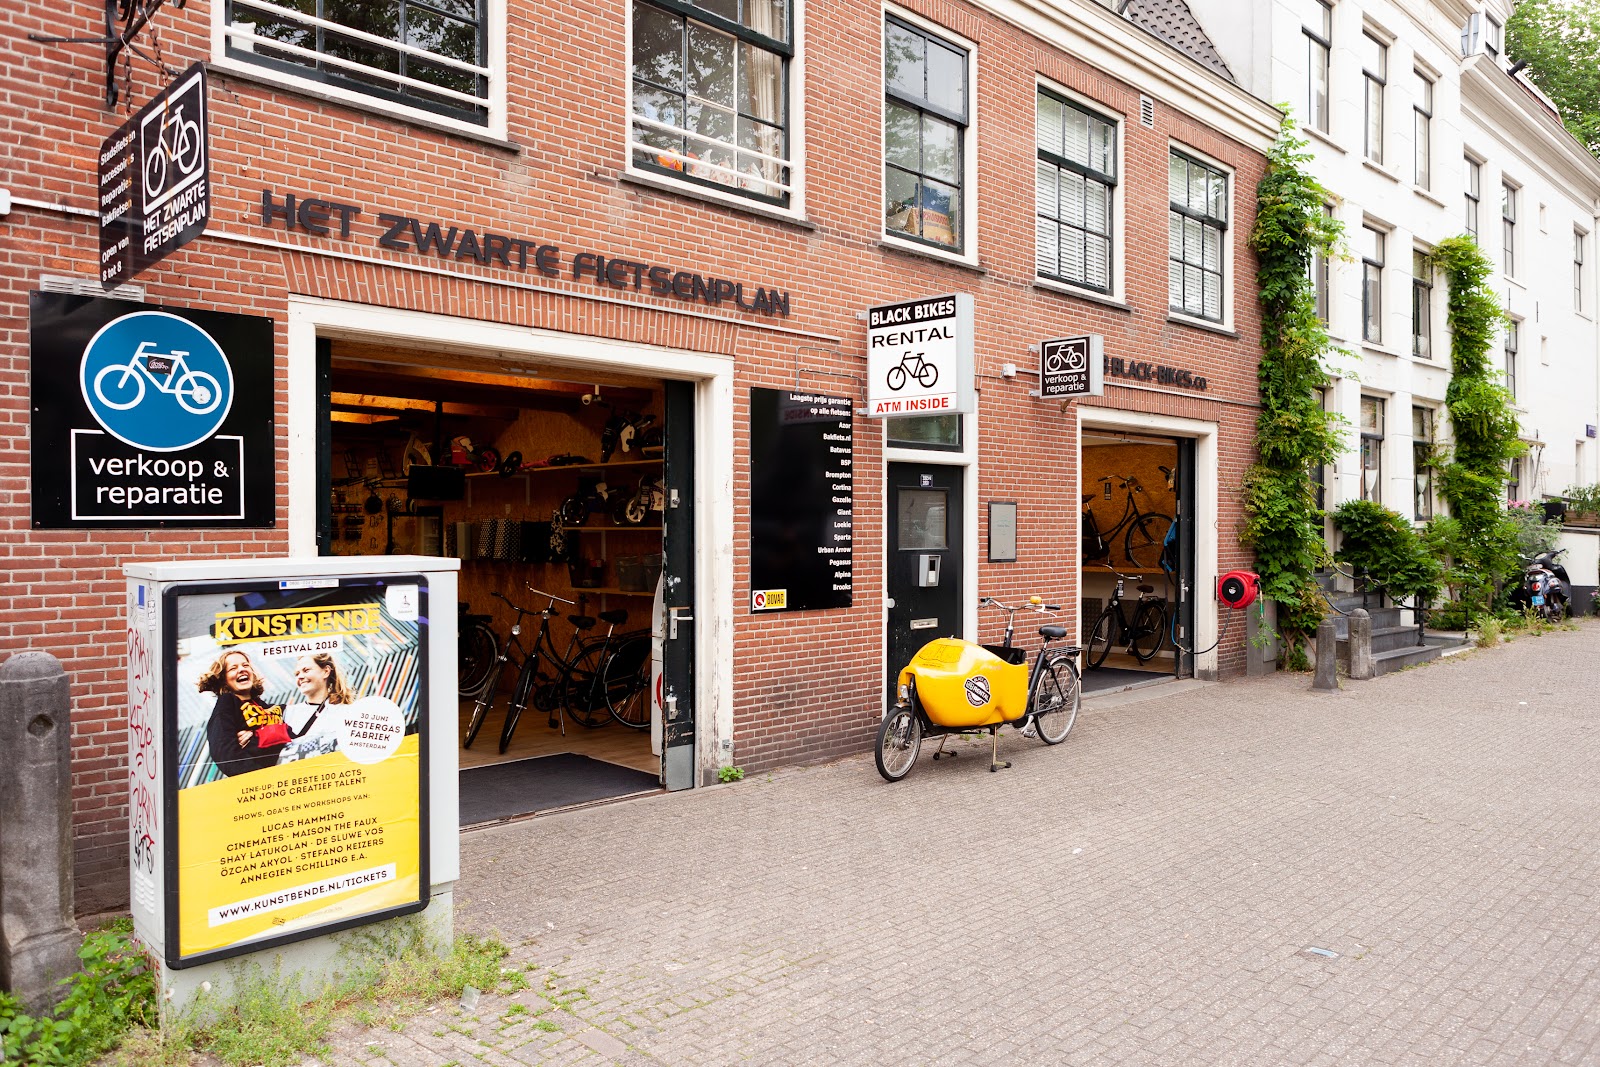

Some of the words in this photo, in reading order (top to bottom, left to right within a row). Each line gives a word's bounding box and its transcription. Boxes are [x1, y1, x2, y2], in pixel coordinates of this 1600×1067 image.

[100, 130, 136, 166] Stadsfietsen
[101, 153, 134, 186] Accessoires
[101, 178, 132, 207] Reparaties
[102, 199, 132, 227] Bakfietsen
[143, 209, 161, 236] HET
[164, 179, 205, 223] ZWARTE
[144, 199, 206, 255] FIETSENPLAN
[102, 245, 117, 263] Open
[118, 237, 129, 250] van
[262, 189, 360, 238] HET
[379, 211, 560, 276] ZWARTE
[574, 251, 789, 316] FIETSENPLAN
[102, 270, 107, 281] 8
[108, 265, 116, 279] tot
[117, 261, 122, 273] 8
[871, 307, 911, 326] BLACK
[914, 300, 954, 319] BIKES
[873, 326, 954, 348] RENTAL
[1045, 375, 1079, 384] verkoop
[1046, 382, 1085, 394] reparatie
[790, 393, 813, 403] Laagste
[814, 395, 827, 404] prijs
[828, 398, 851, 406] garantie
[830, 408, 851, 416] fietsen:
[876, 401, 901, 413] ATM
[906, 397, 948, 410] INSIDE
[823, 433, 851, 441] Bakfiets.nl
[89, 453, 203, 481] verkoop
[213, 461, 229, 477] &
[825, 471, 852, 479] Brompton
[96, 483, 223, 509] reparatie
[833, 534, 851, 542] Sparta
[215, 609, 380, 639] KUNSTBENDE
[263, 644, 312, 656] FESTIVAL
[316, 640, 337, 651] 2018
[344, 719, 400, 733] WESTERGAS
[350, 730, 390, 741] FABRIEK
[349, 741, 386, 749] AMSTERDAM
[236, 794, 256, 804] VAN
[259, 789, 286, 800] JONG
[289, 782, 332, 795] CREATIEF
[334, 776, 367, 787] TALENT
[241, 783, 275, 795] LINE-UP:
[277, 779, 289, 788] DE
[291, 775, 318, 786] BESTE
[321, 773, 336, 781] 100
[339, 769, 362, 778] ACTS
[303, 796, 351, 809] WORKSHOPS
[353, 793, 370, 801] VAN:
[227, 834, 284, 852] CINEMATES
[292, 826, 331, 839] MAISON
[334, 822, 351, 831] THE
[354, 817, 378, 827] FAUX
[262, 821, 295, 833] LUCAS
[297, 811, 345, 827] HAMMING
[220, 854, 246, 865] SHAY
[250, 841, 308, 860] LATUKOLAN
[316, 838, 328, 846] DE
[331, 831, 362, 843] SLUWE
[365, 827, 384, 836] VOS
[220, 862, 257, 877] ÖZCAN
[259, 855, 293, 869] AKYOL
[301, 846, 343, 860] STEFANO
[346, 838, 384, 851] KEIZERS
[240, 864, 293, 885] ANNEGIEN
[295, 856, 348, 873] SCHILLING
[351, 853, 368, 861] E.A.
[219, 870, 388, 919] WWW.KUNSTBENDE.NL/TICKETS
